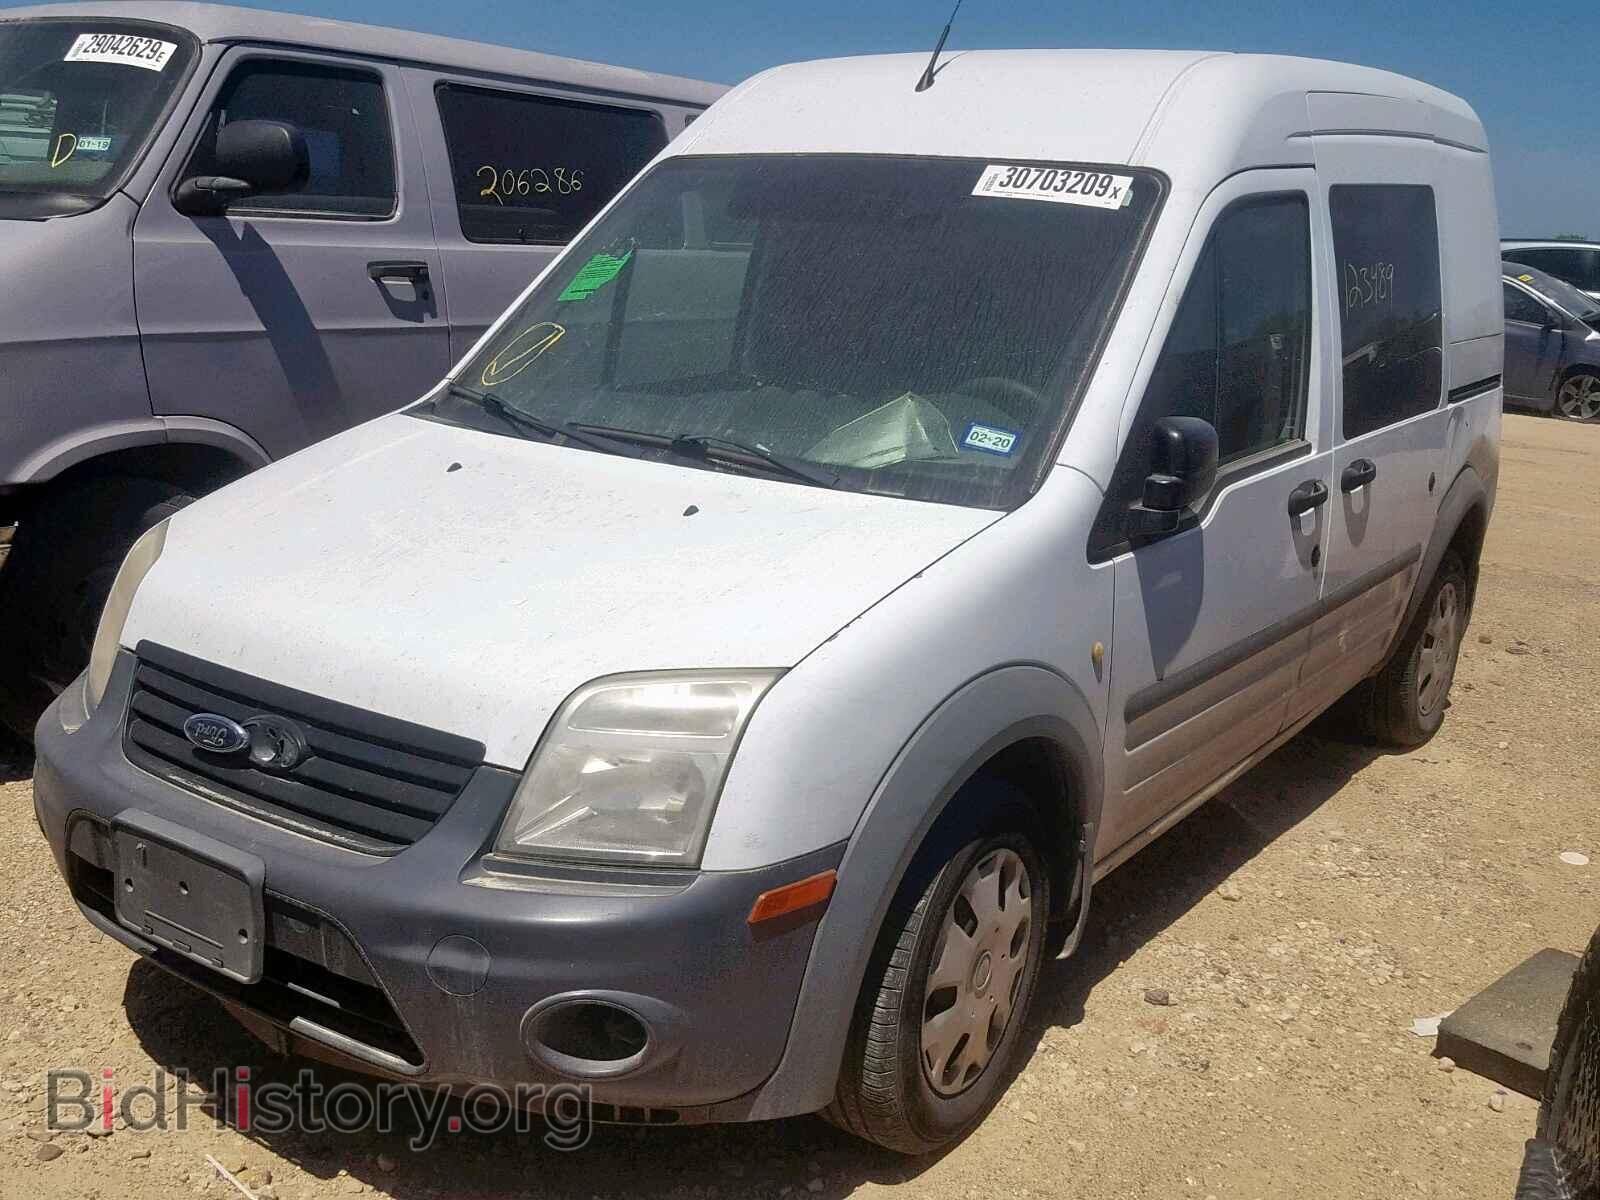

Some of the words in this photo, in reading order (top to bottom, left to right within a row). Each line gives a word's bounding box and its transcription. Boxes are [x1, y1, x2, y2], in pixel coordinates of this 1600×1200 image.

[79, 140, 109, 149] 01-19
[477, 166, 584, 206] 206286
[970, 431, 1010, 448] 02-20
[195, 723, 227, 746] Ford
